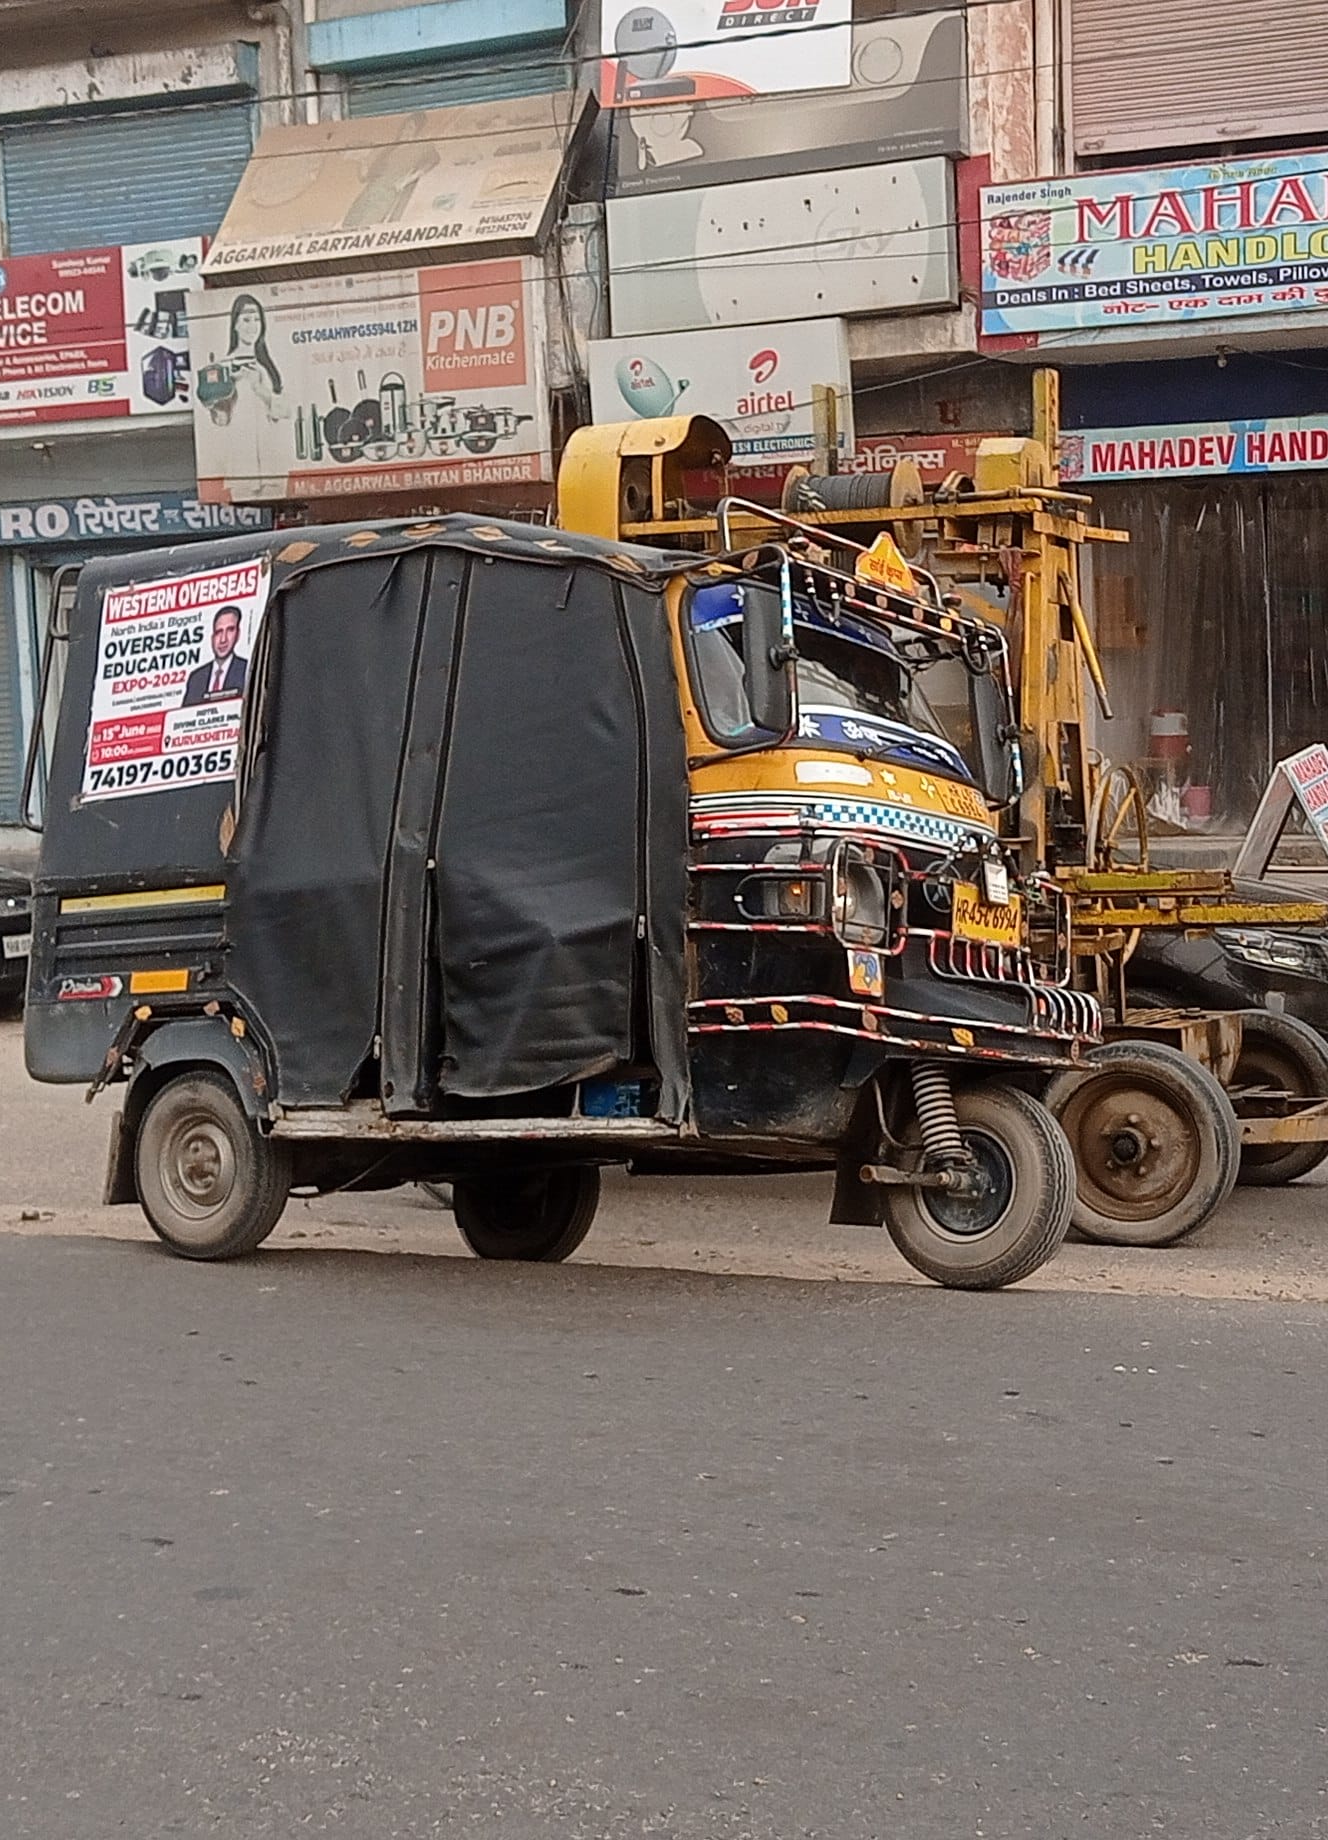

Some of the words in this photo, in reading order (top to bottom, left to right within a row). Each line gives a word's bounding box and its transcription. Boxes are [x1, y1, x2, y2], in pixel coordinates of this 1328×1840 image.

[725, 9, 809, 27] DIRECT
[987, 190, 1037, 206] Rajender
[1040, 186, 1072, 201] Singh
[209, 239, 304, 267] AGGARWAL
[307, 234, 373, 255] BARTAN
[377, 223, 462, 246] BHANDAR
[996, 290, 1047, 305] Deals
[1052, 288, 1069, 300] In
[1084, 282, 1121, 297] Bed
[1126, 278, 1196, 294] Sheets,
[1202, 269, 1274, 291] Towels,
[1168, 298, 1208, 310] एक
[1218, 292, 1263, 307] दाम
[1271, 283, 1305, 302] की
[428, 303, 515, 353] PNB
[426, 350, 516, 371] Kitchenmate
[630, 376, 656, 391] airtel
[736, 390, 795, 416] airtel
[754, 436, 816, 452] ELECTRONICS
[1091, 433, 1235, 474] MAHADEV
[324, 470, 401, 494] AGGARWAL
[404, 467, 460, 488] BARTAN
[462, 464, 532, 483] BHANDAR
[0, 504, 69, 540] RO
[74, 498, 161, 535] रिपेयर
[108, 586, 177, 620] WESTERN
[178, 569, 257, 607] OVERSEAS
[111, 622, 136, 637] North
[167, 611, 203, 628] Biggest
[104, 626, 204, 659] OVERSEAS
[103, 648, 200, 680] EDUCATION
[112, 670, 186, 695] EXPO-2022
[120, 722, 146, 737] June
[172, 727, 240, 748] KURUKSHETRA
[90, 750, 232, 791] 74197-00365
